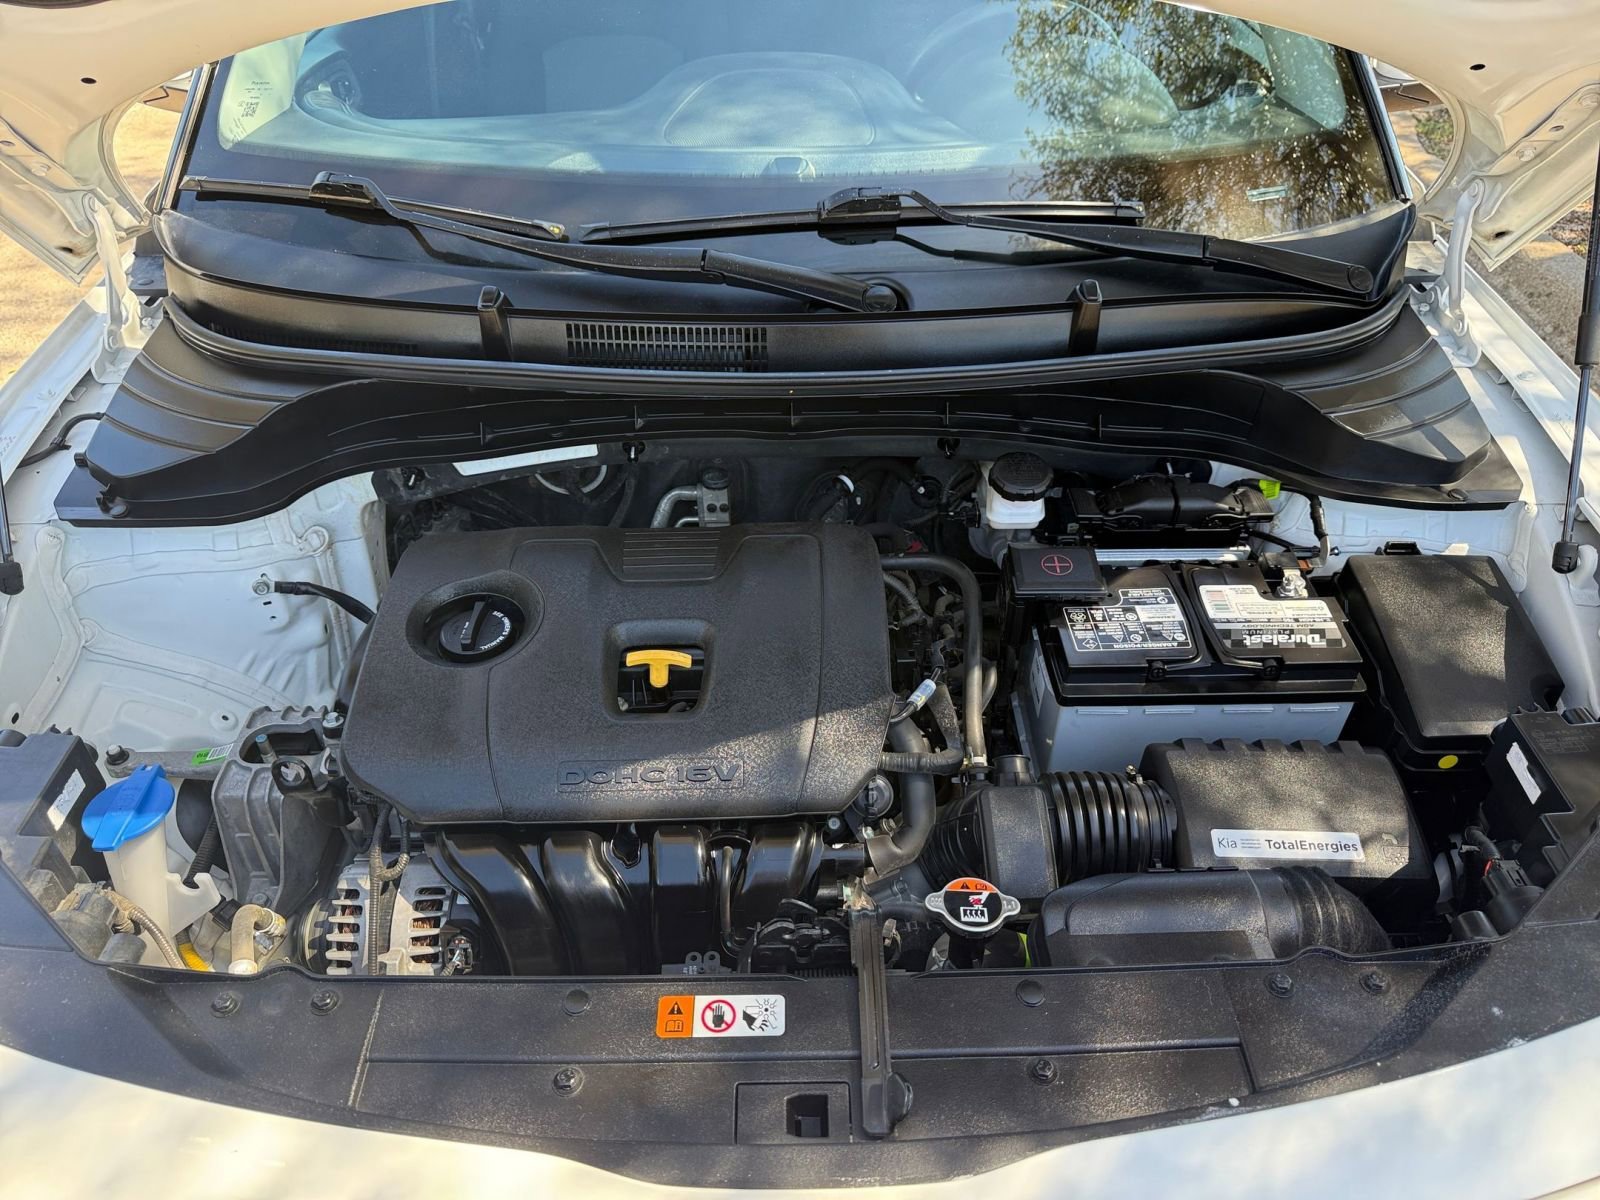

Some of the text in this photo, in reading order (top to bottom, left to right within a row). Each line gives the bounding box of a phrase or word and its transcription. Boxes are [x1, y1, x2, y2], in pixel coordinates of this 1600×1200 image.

[479, 635, 505, 650] MANUAL
[1242, 634, 1326, 646] Duralast
[560, 764, 739, 785] DOHC 16V
[1217, 837, 1238, 849] Kia
[1265, 839, 1358, 853] TotalEnergies
